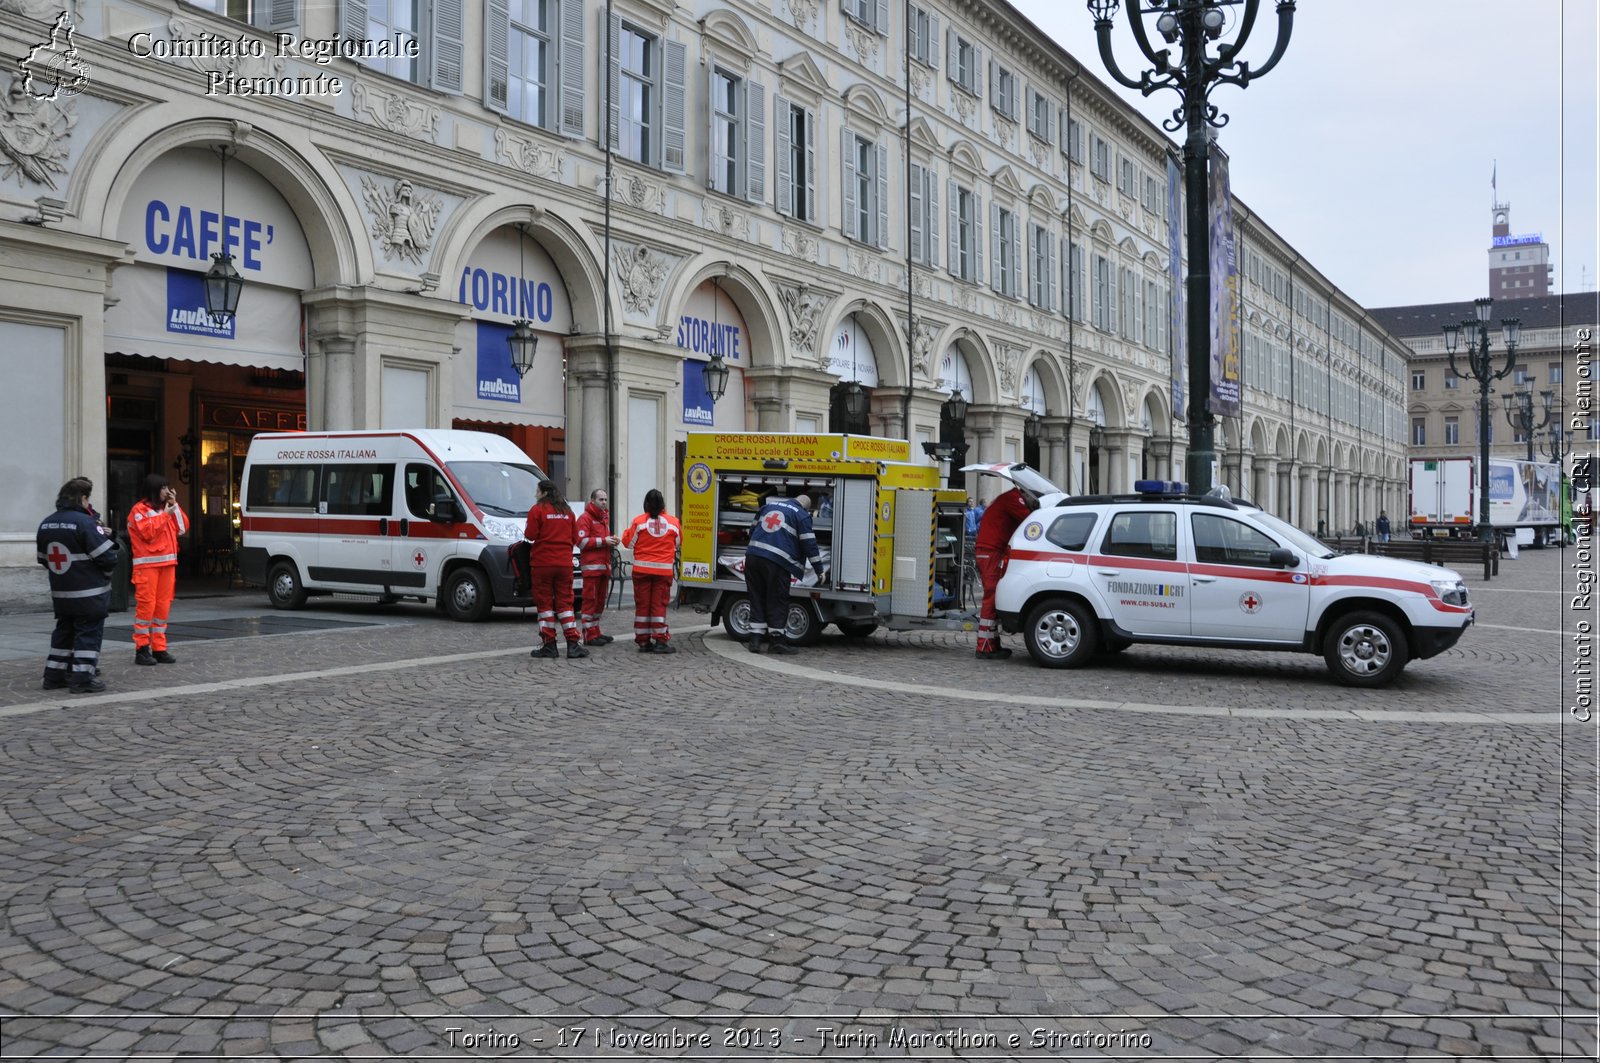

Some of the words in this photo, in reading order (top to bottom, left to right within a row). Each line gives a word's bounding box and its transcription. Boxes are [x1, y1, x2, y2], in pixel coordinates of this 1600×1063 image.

[145, 200, 274, 271] CAFFE'
[459, 266, 553, 323] TORINO
[479, 377, 518, 396] LAVAZZA
[714, 435, 744, 444] CROCE
[746, 435, 776, 444] ROSSA
[778, 435, 818, 445] ITALIANA
[852, 440, 870, 451] CROCE
[870, 441, 887, 452] ROSSA
[887, 442, 906, 454] ITALIANA
[277, 450, 305, 459] CROCE
[307, 450, 335, 459] ROSSA
[337, 450, 377, 459] ITALIANA
[716, 446, 752, 455] Comitato
[754, 446, 781, 456] Locale
[783, 447, 791, 456] di
[793, 447, 815, 457] Susa
[1107, 581, 1158, 596] FONDAZIONE
[1169, 584, 1184, 597] CRT
[1120, 599, 1176, 609] WWW.CRI-SUSA.IT
